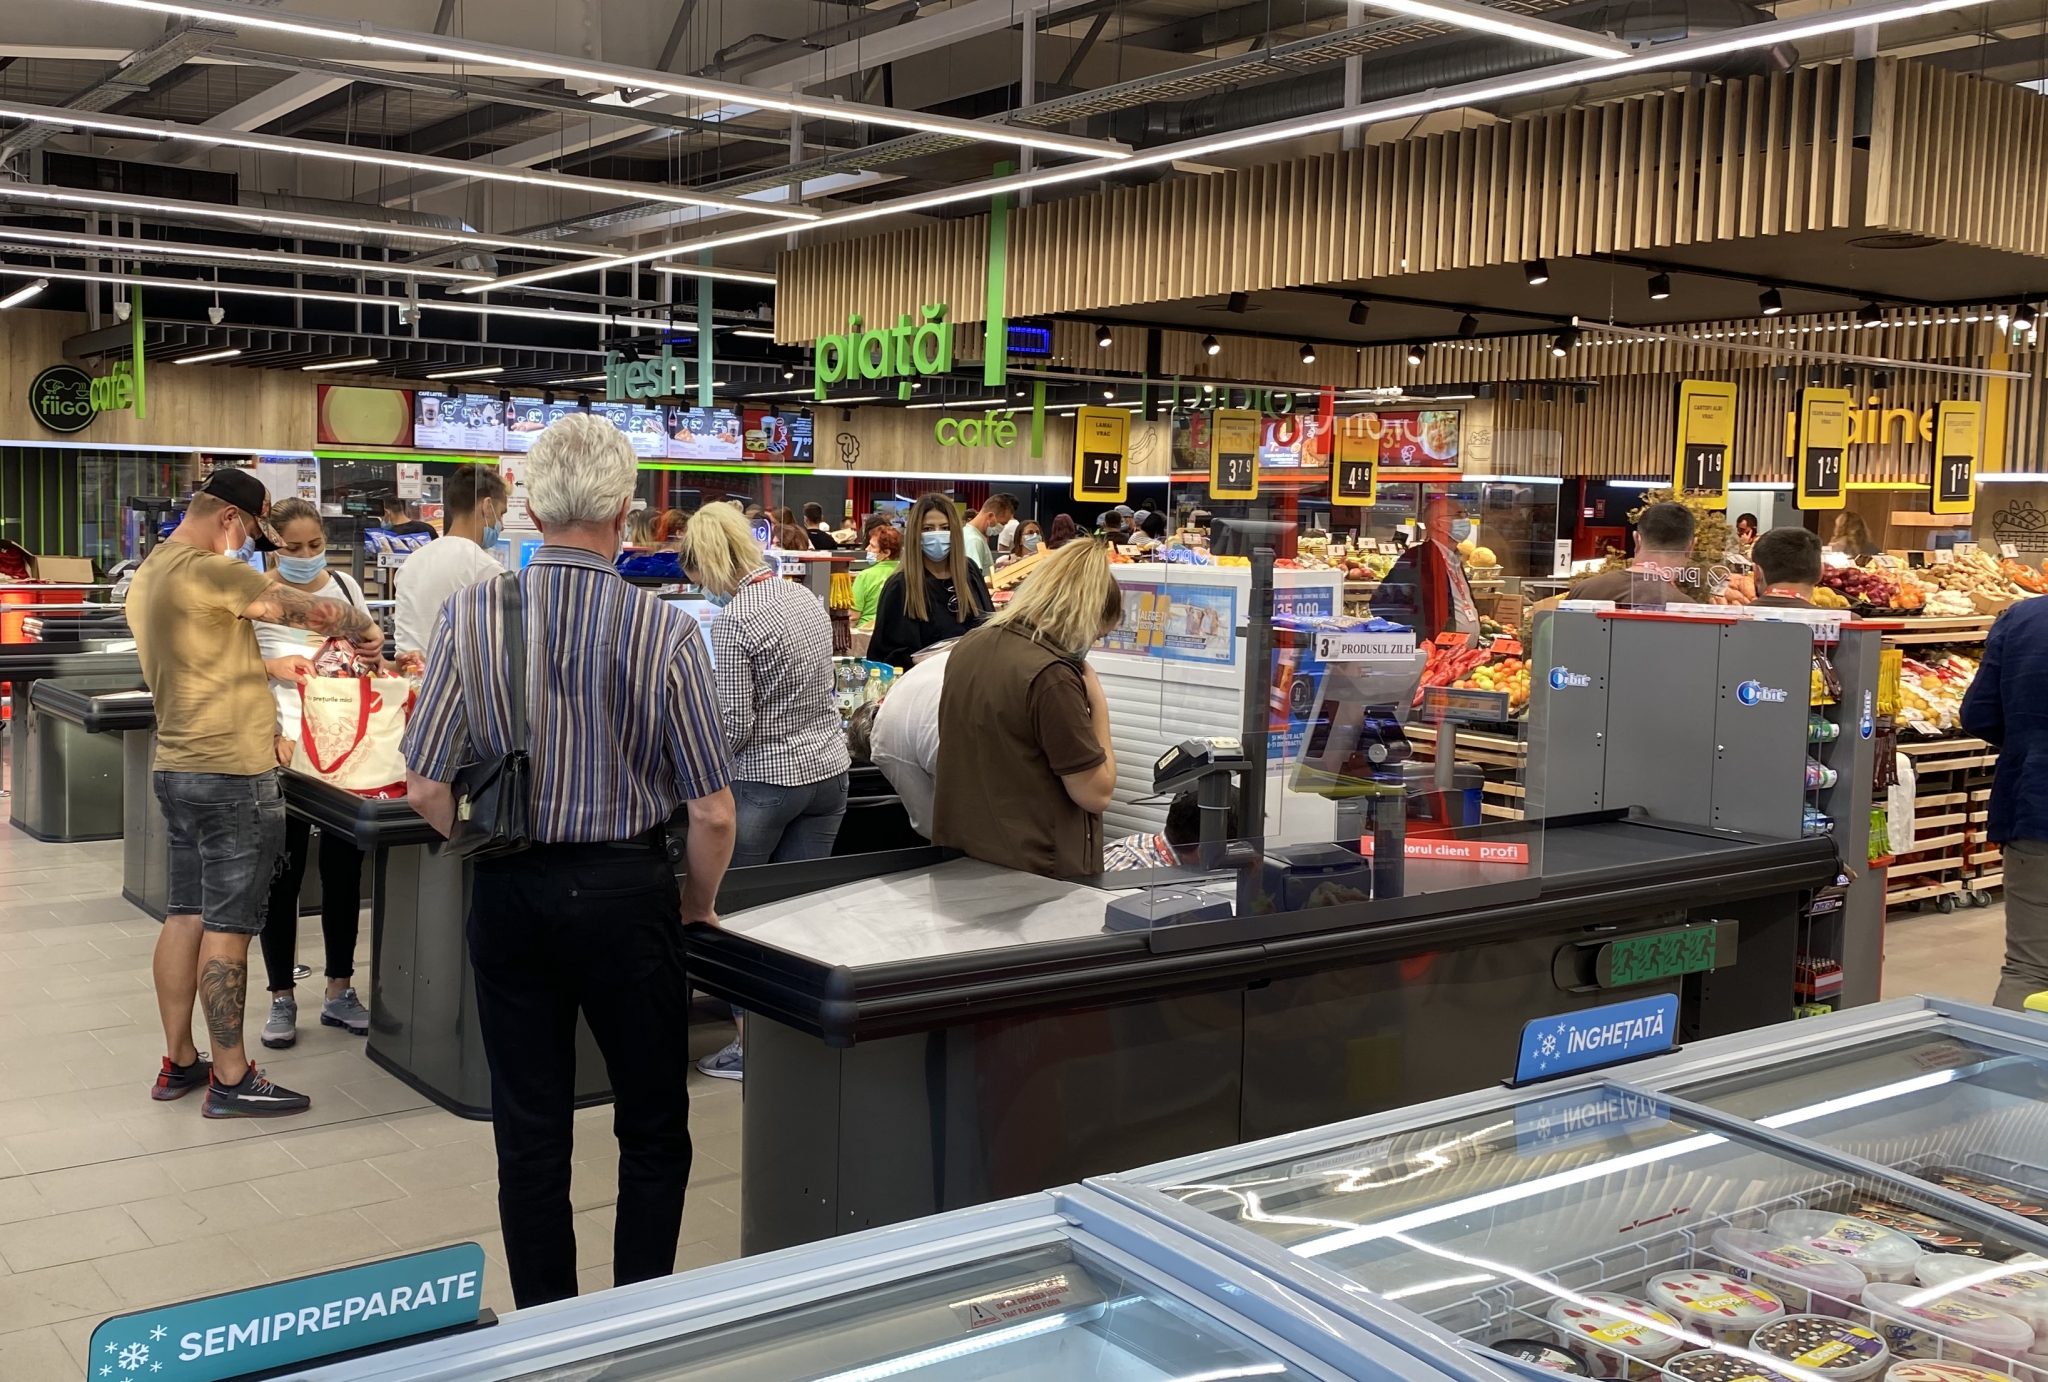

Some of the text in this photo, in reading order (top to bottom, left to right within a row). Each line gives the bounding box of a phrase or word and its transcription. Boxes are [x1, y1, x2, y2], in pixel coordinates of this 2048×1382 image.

[604, 345, 685, 400] fresh
[815, 304, 953, 400] piață
[90, 361, 133, 412] café
[935, 410, 1017, 448] café
[1341, 644, 1415, 654] PRODUSUL ZILEI
[1435, 846, 1470, 857] client
[1480, 846, 1518, 858] profi
[1567, 1008, 1664, 1054] ÎNGHEȚATĂ
[178, 1270, 477, 1361] SEMIPREPARATE
